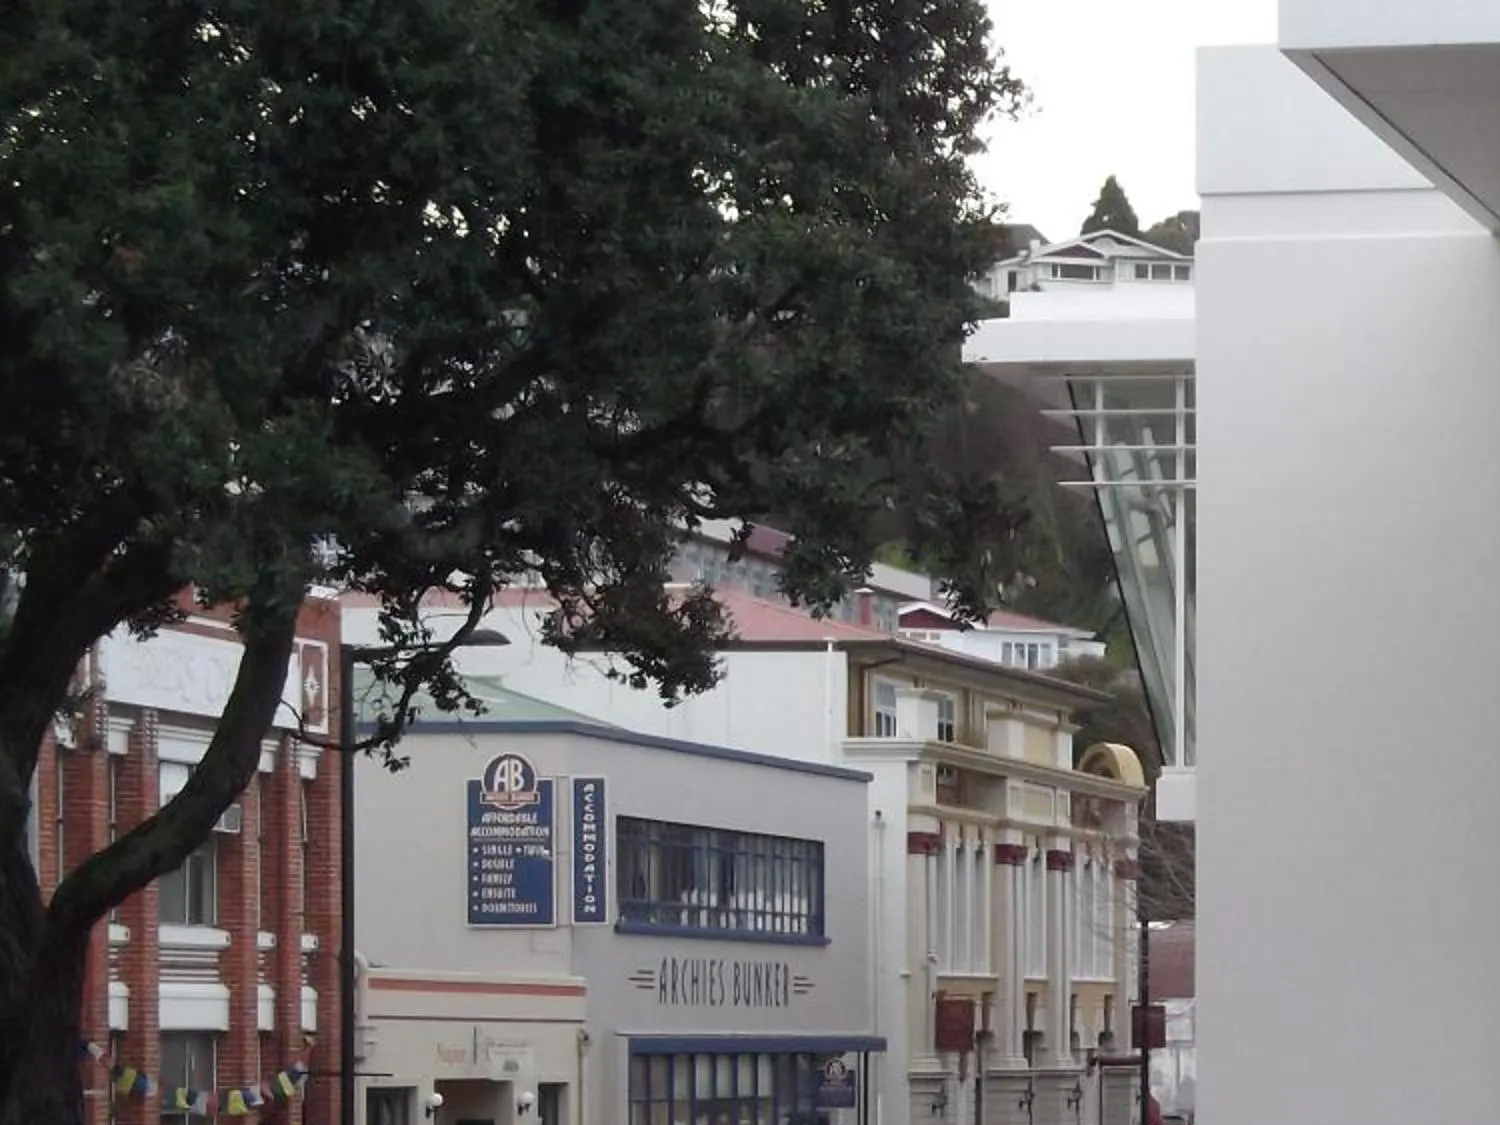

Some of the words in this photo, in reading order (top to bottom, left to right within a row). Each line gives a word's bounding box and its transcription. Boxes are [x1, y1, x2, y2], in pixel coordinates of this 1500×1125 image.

[494, 759, 524, 792] AB
[583, 784, 596, 912] ACCOMMODATION
[659, 956, 725, 1006] ARCHIES
[732, 960, 789, 1007] BUNKER
